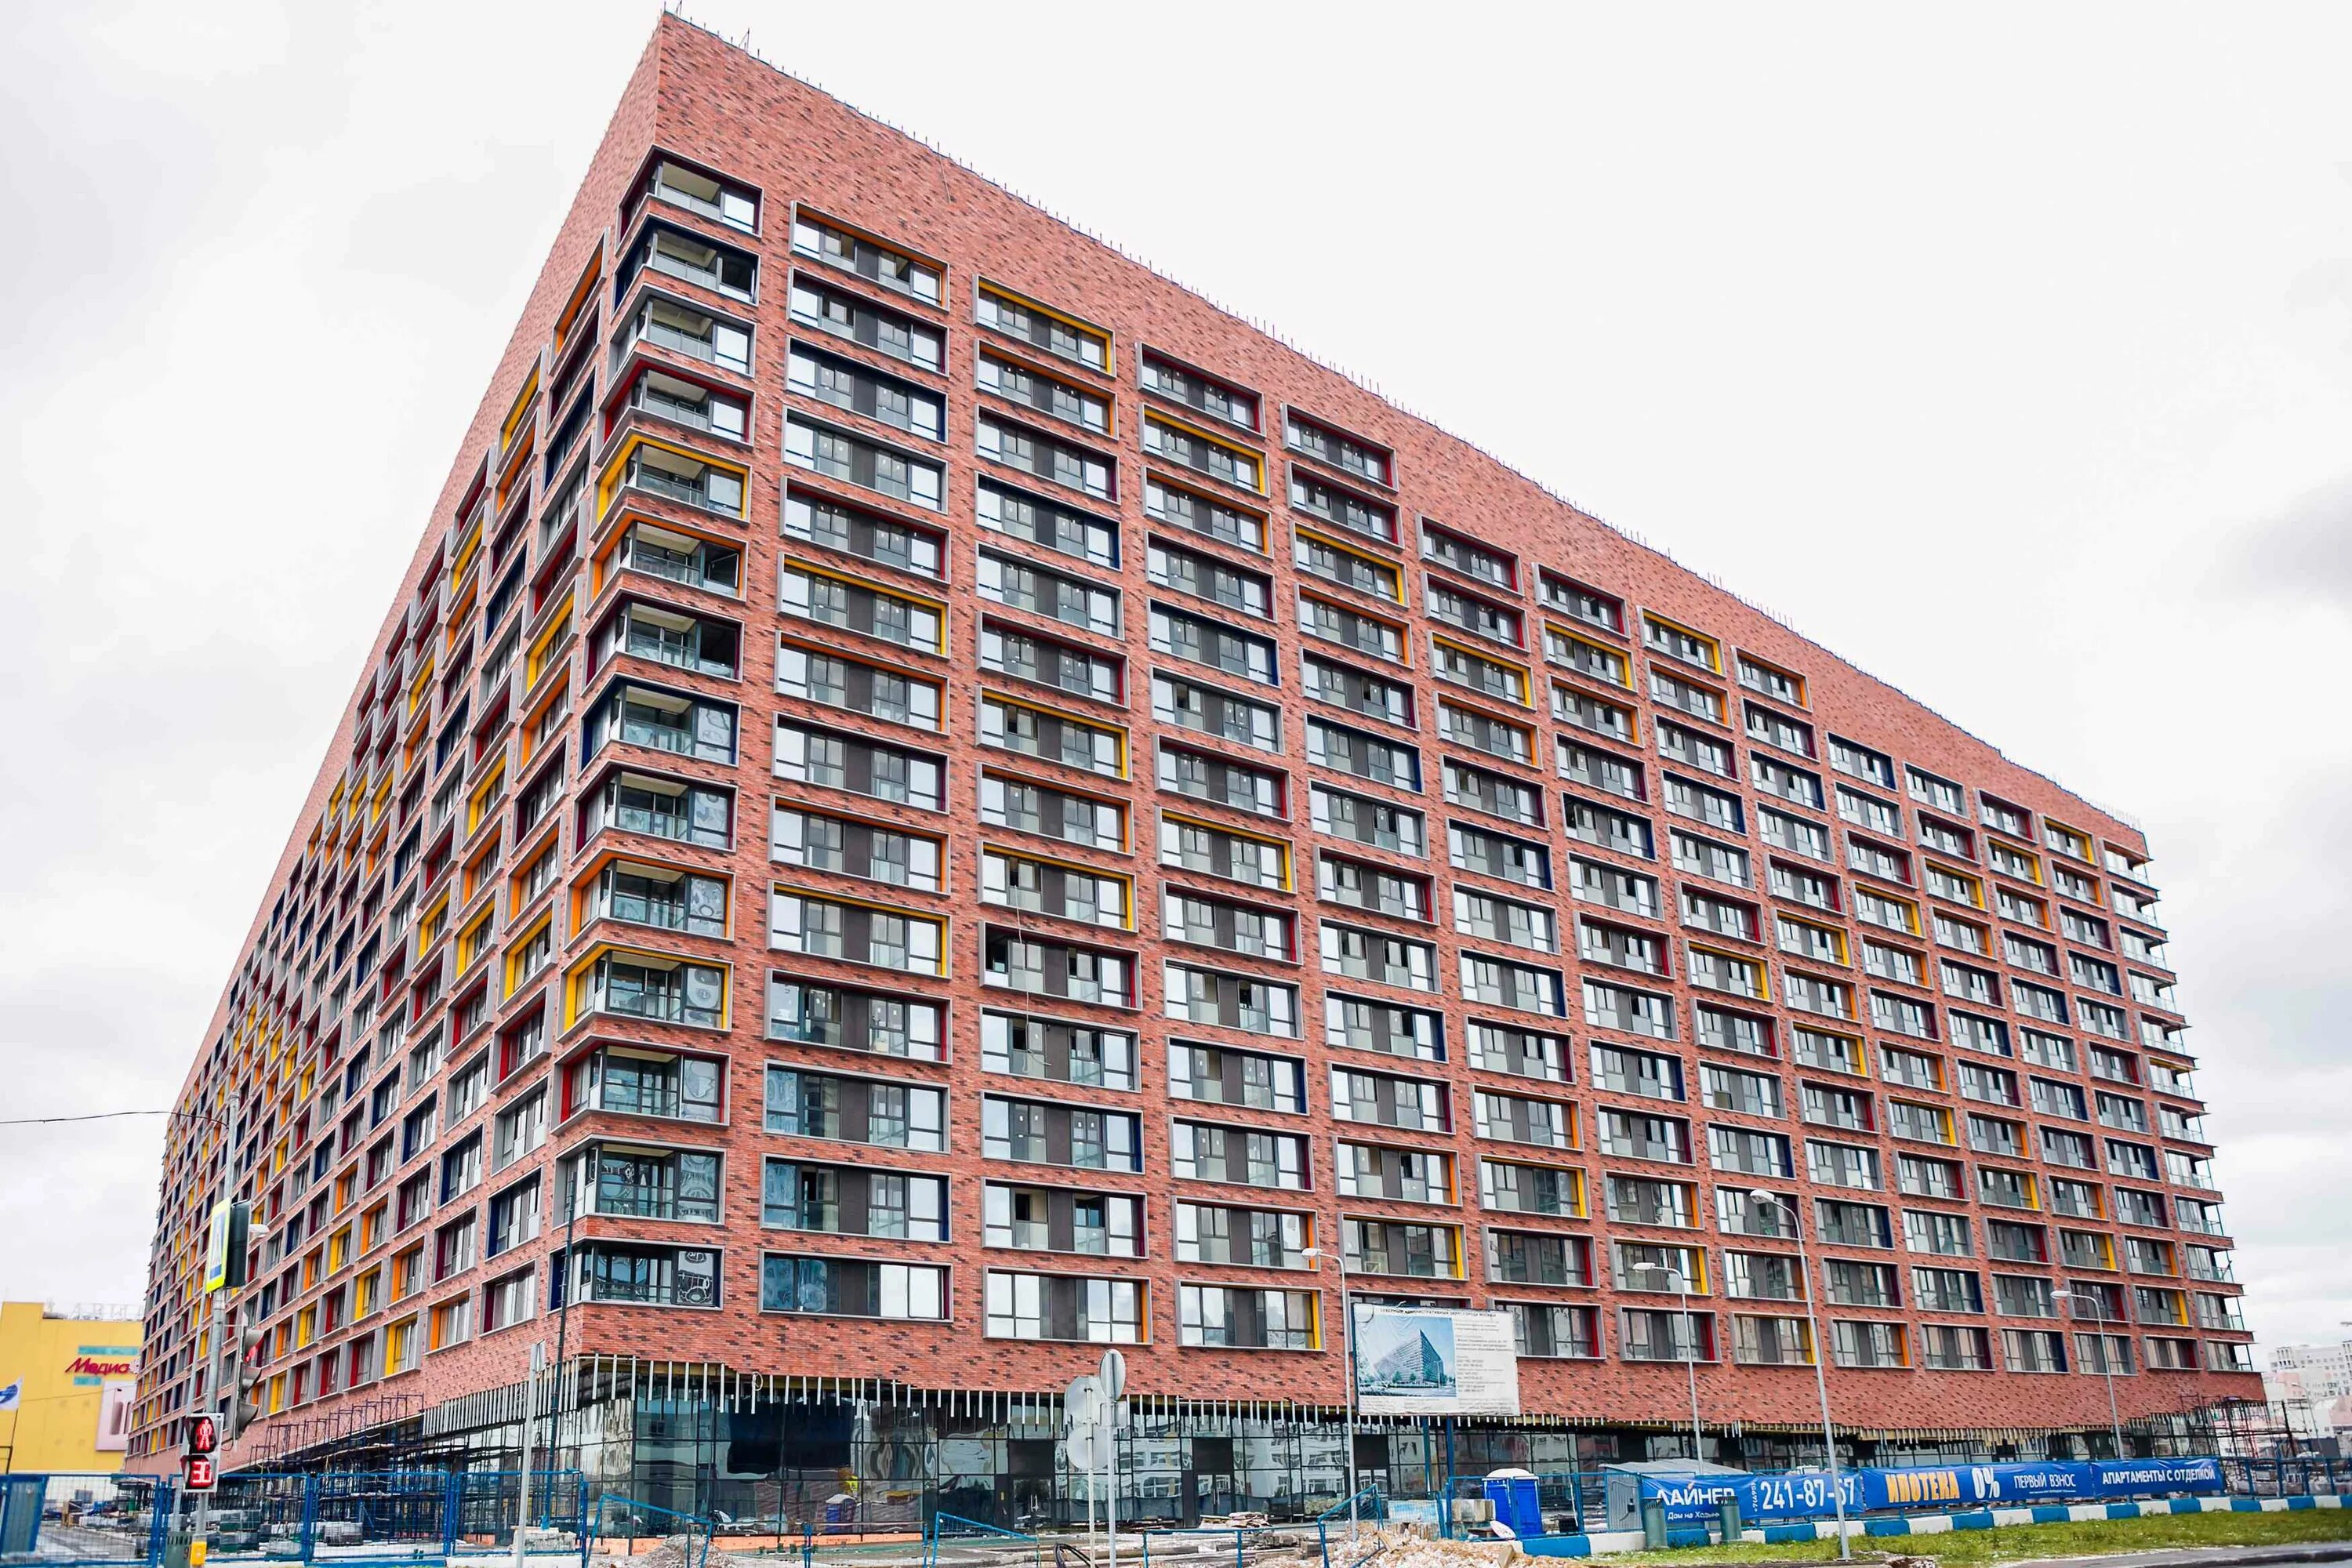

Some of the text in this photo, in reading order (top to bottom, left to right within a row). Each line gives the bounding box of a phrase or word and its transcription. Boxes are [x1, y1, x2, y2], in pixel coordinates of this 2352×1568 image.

[2013, 1472, 2077, 1489] ПЕРВЫЙ ВЗНОС
[2102, 1465, 2216, 1485] АПАРТАМЕНТЫ С ОТДЕЛКОЙ
[1885, 1467, 2000, 1503] ИПОТЕКА 0%
[1668, 1512, 1683, 1520] Дом
